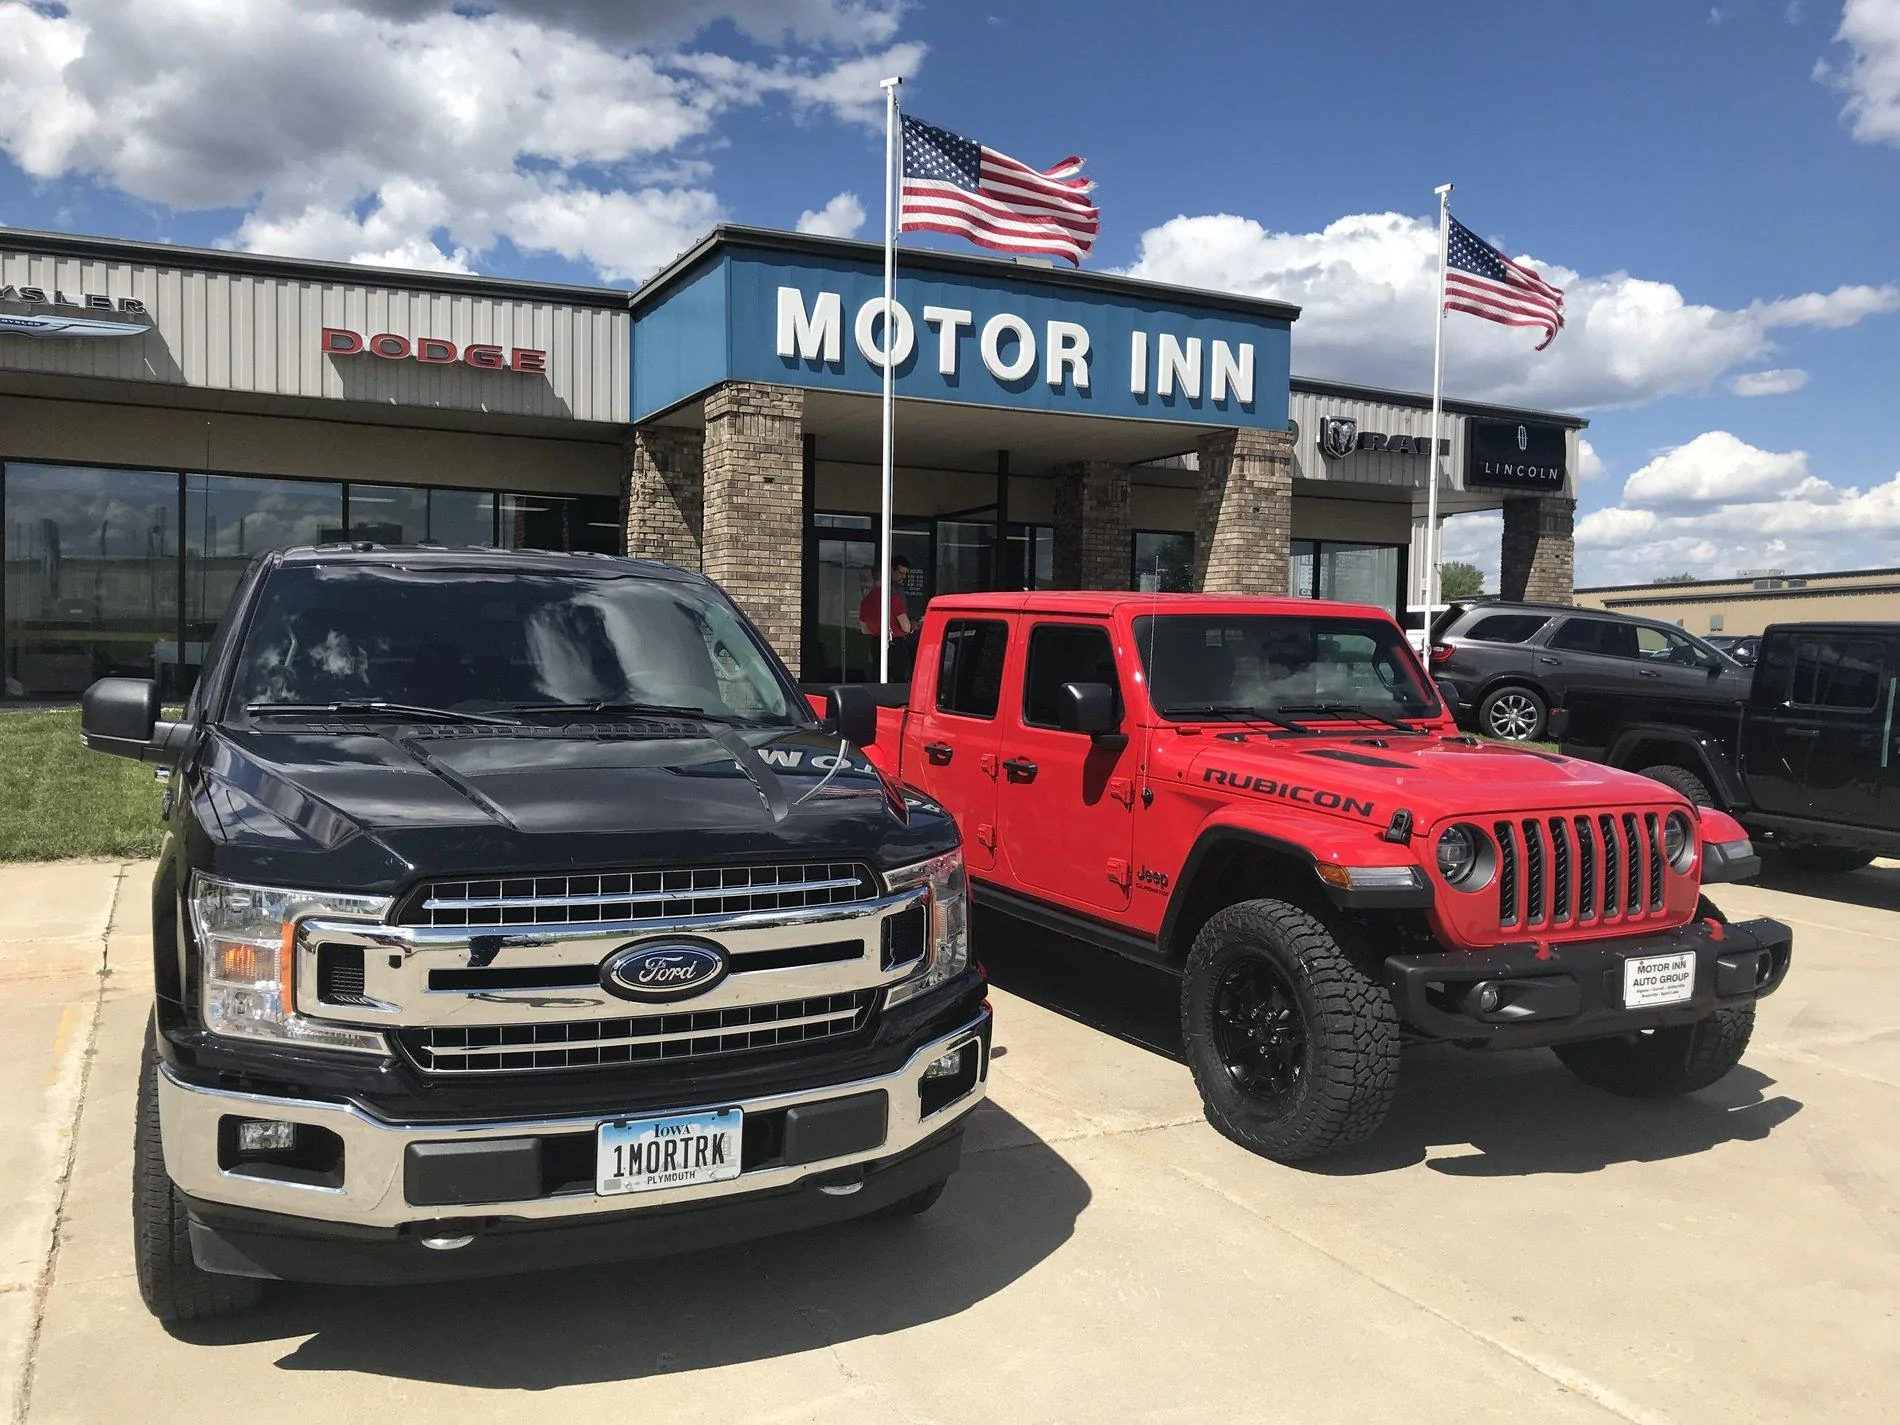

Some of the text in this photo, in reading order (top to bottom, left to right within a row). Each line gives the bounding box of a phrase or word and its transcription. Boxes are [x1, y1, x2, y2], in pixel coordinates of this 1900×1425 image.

[322, 327, 547, 374] DODGE
[777, 286, 1254, 404] MOTOR INN
[1485, 462, 1558, 480] LINCOLN
[1203, 768, 1374, 817] RUBICON
[1137, 865, 1169, 890] Jeep
[639, 956, 698, 983] Ford
[1633, 973, 1689, 987] AUTO GROUP
[1637, 960, 1686, 974] MOTOR INN
[613, 1132, 725, 1178] 1MORTRK
[647, 1170, 696, 1185] PLYMOUTH
